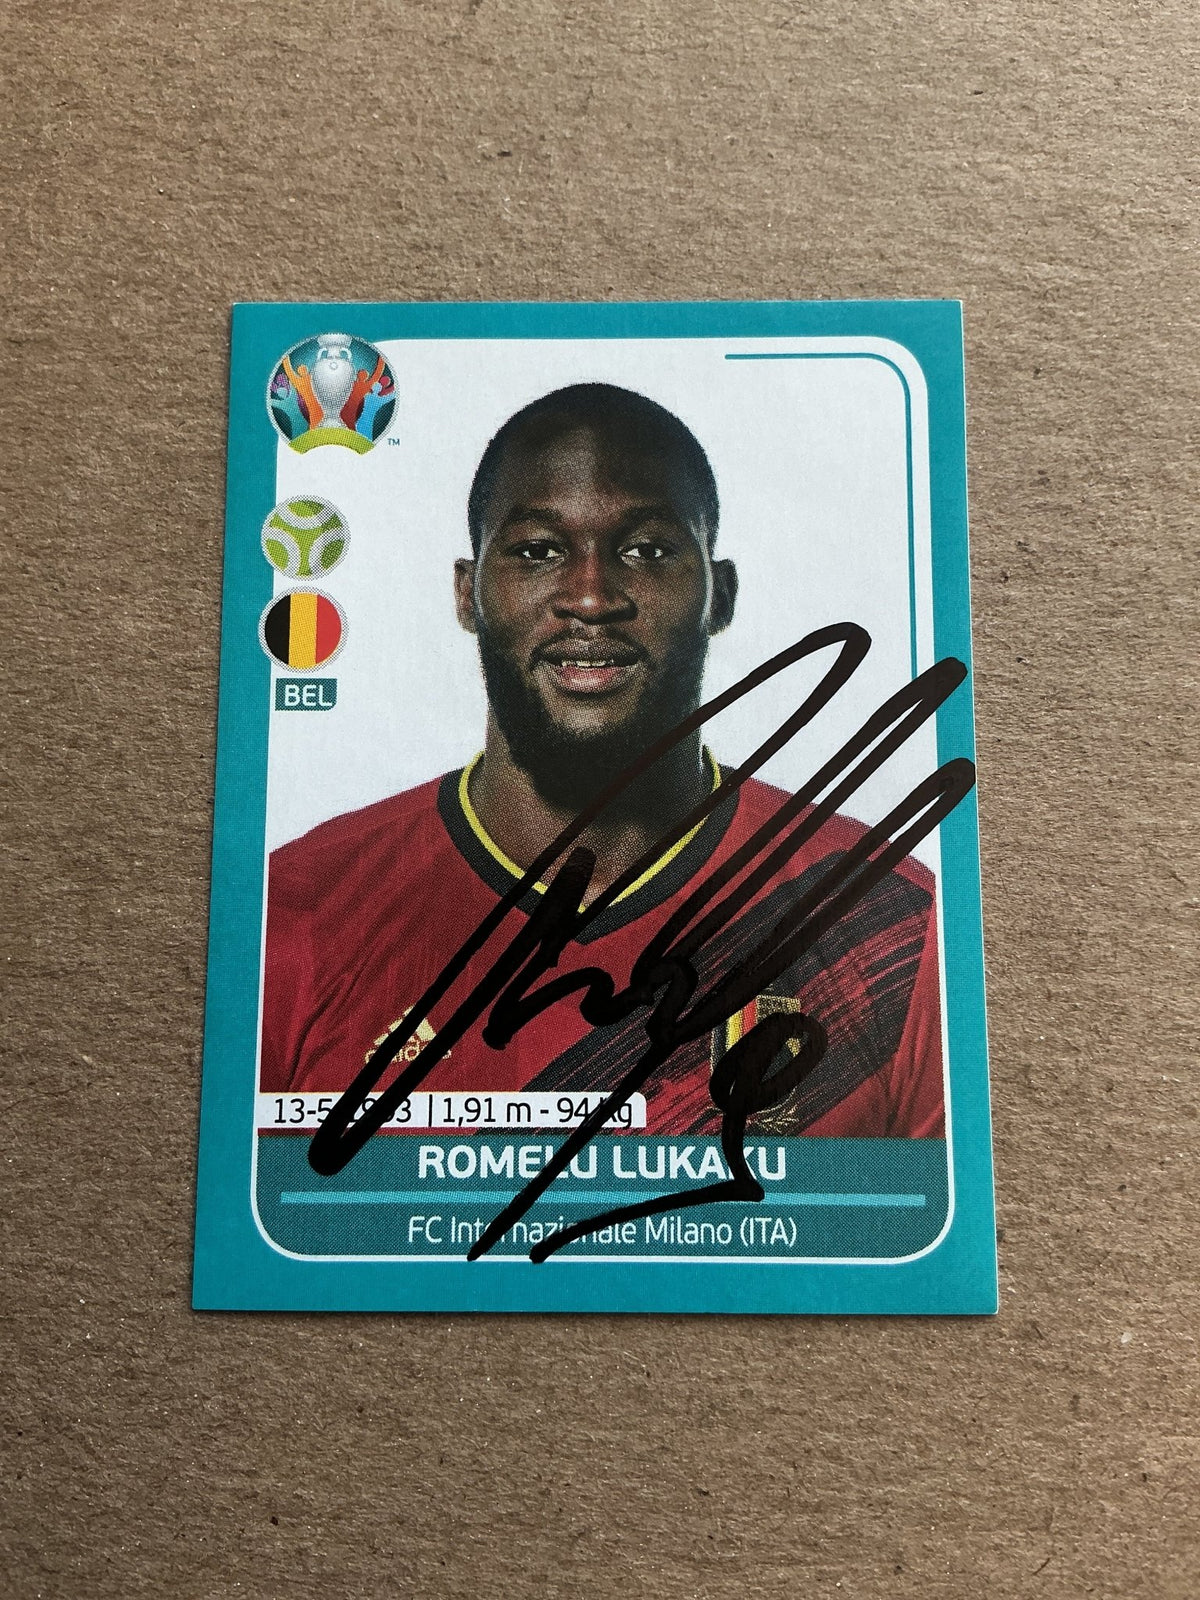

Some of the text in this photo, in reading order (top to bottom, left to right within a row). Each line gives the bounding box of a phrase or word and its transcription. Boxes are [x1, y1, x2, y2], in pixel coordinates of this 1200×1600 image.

[387, 438, 401, 446] TM
[284, 684, 333, 707] BEL
[274, 1097, 412, 1124] 13-53
[442, 1097, 497, 1126] 1,91
[506, 1102, 532, 1123] m
[556, 1097, 591, 1123] 94
[407, 1215, 798, 1248] FC Intnaziale Milano (ITA)
